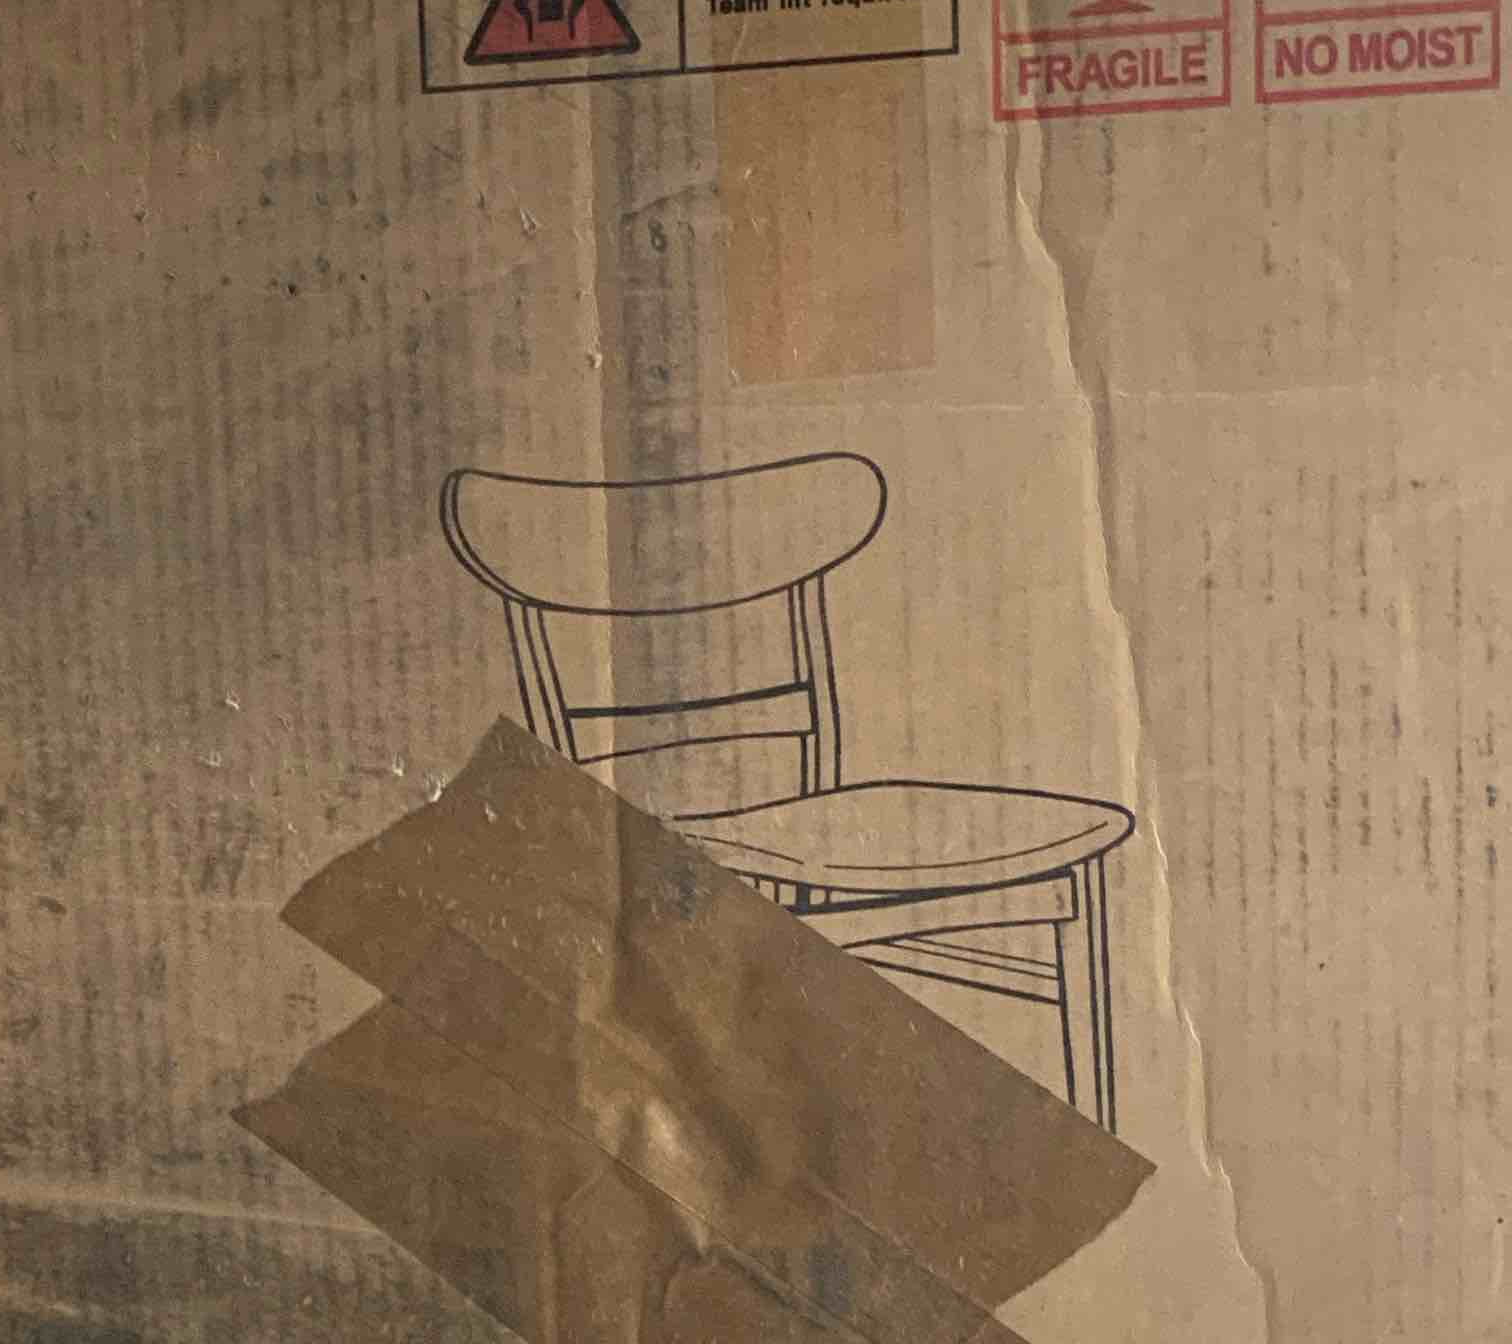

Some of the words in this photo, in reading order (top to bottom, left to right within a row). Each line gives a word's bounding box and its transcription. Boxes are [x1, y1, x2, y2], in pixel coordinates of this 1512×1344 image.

[1017, 43, 1209, 96] FRAGILE
[1274, 34, 1338, 79] NO
[1348, 25, 1483, 74] MOIST
